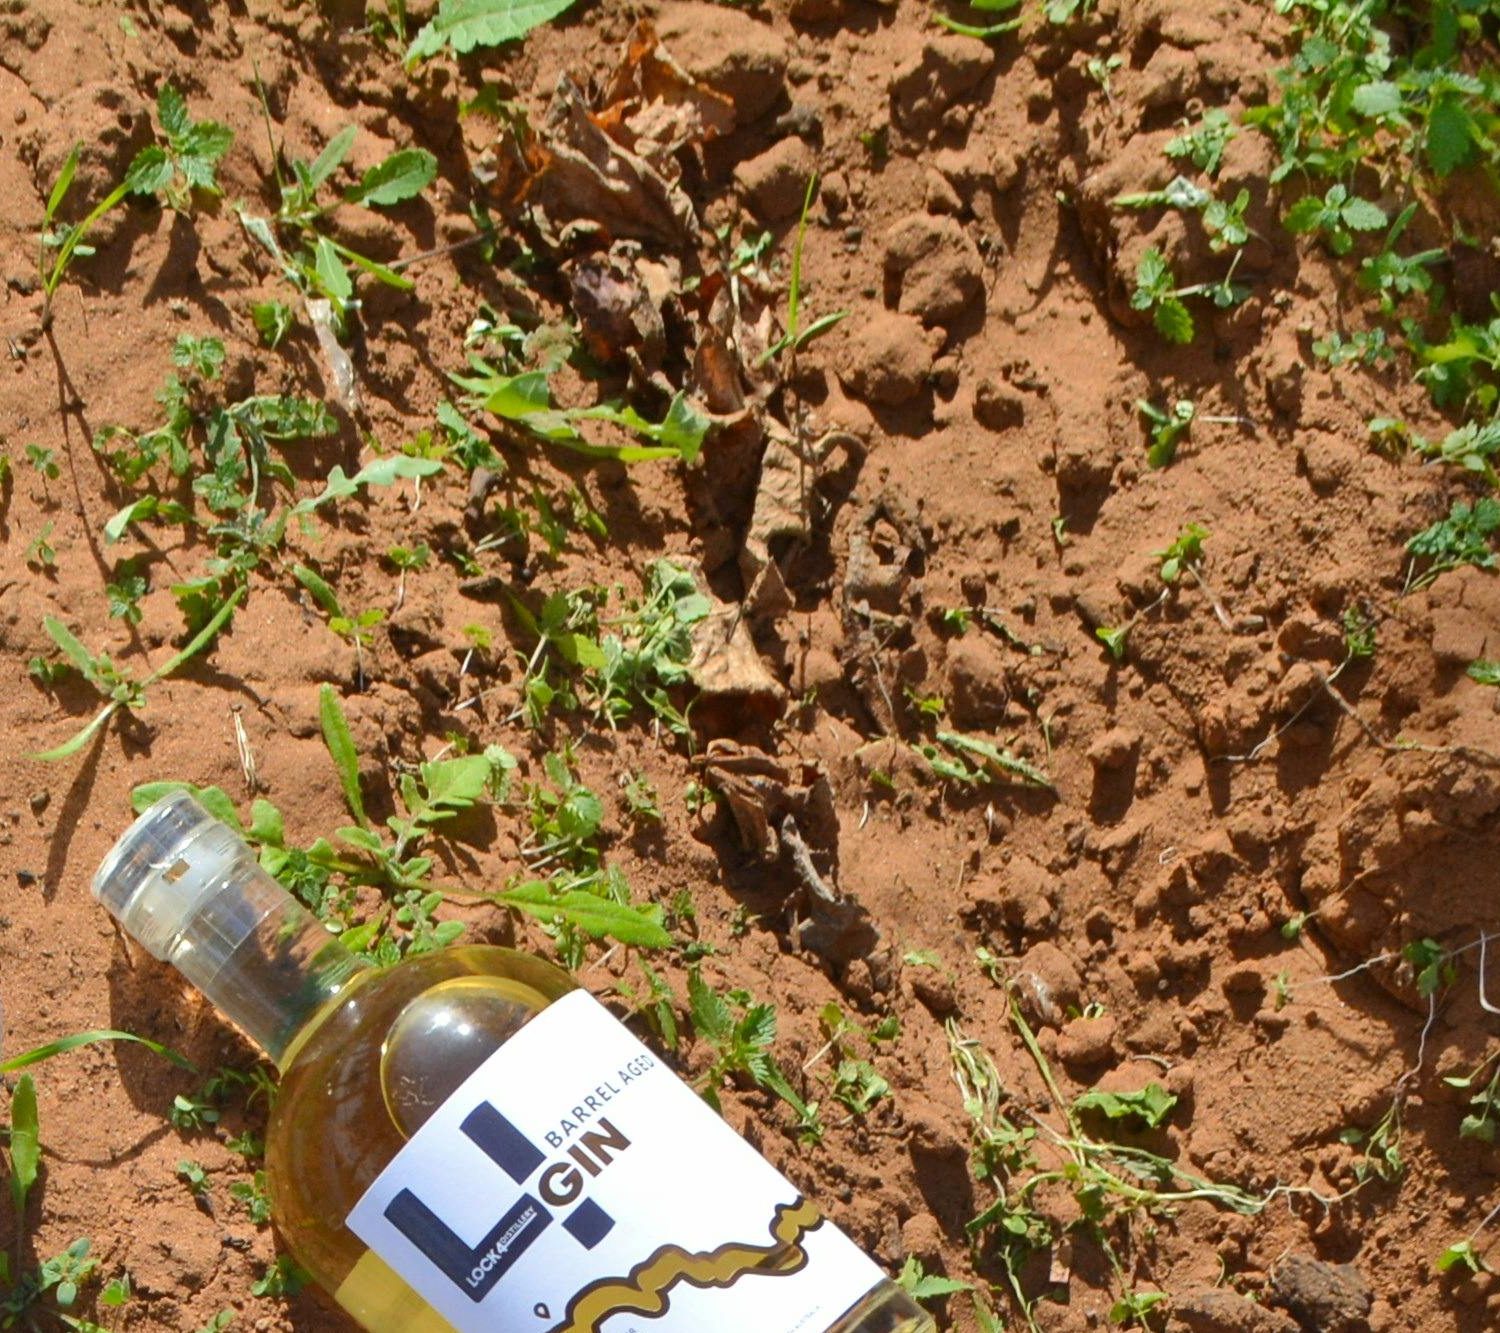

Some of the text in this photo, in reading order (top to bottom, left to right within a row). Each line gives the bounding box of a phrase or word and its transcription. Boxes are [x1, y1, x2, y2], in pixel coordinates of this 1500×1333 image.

[543, 1051, 656, 1149] BARREL AGED
[528, 1114, 633, 1215] GIN
[498, 1204, 536, 1245] DISTILLERY
